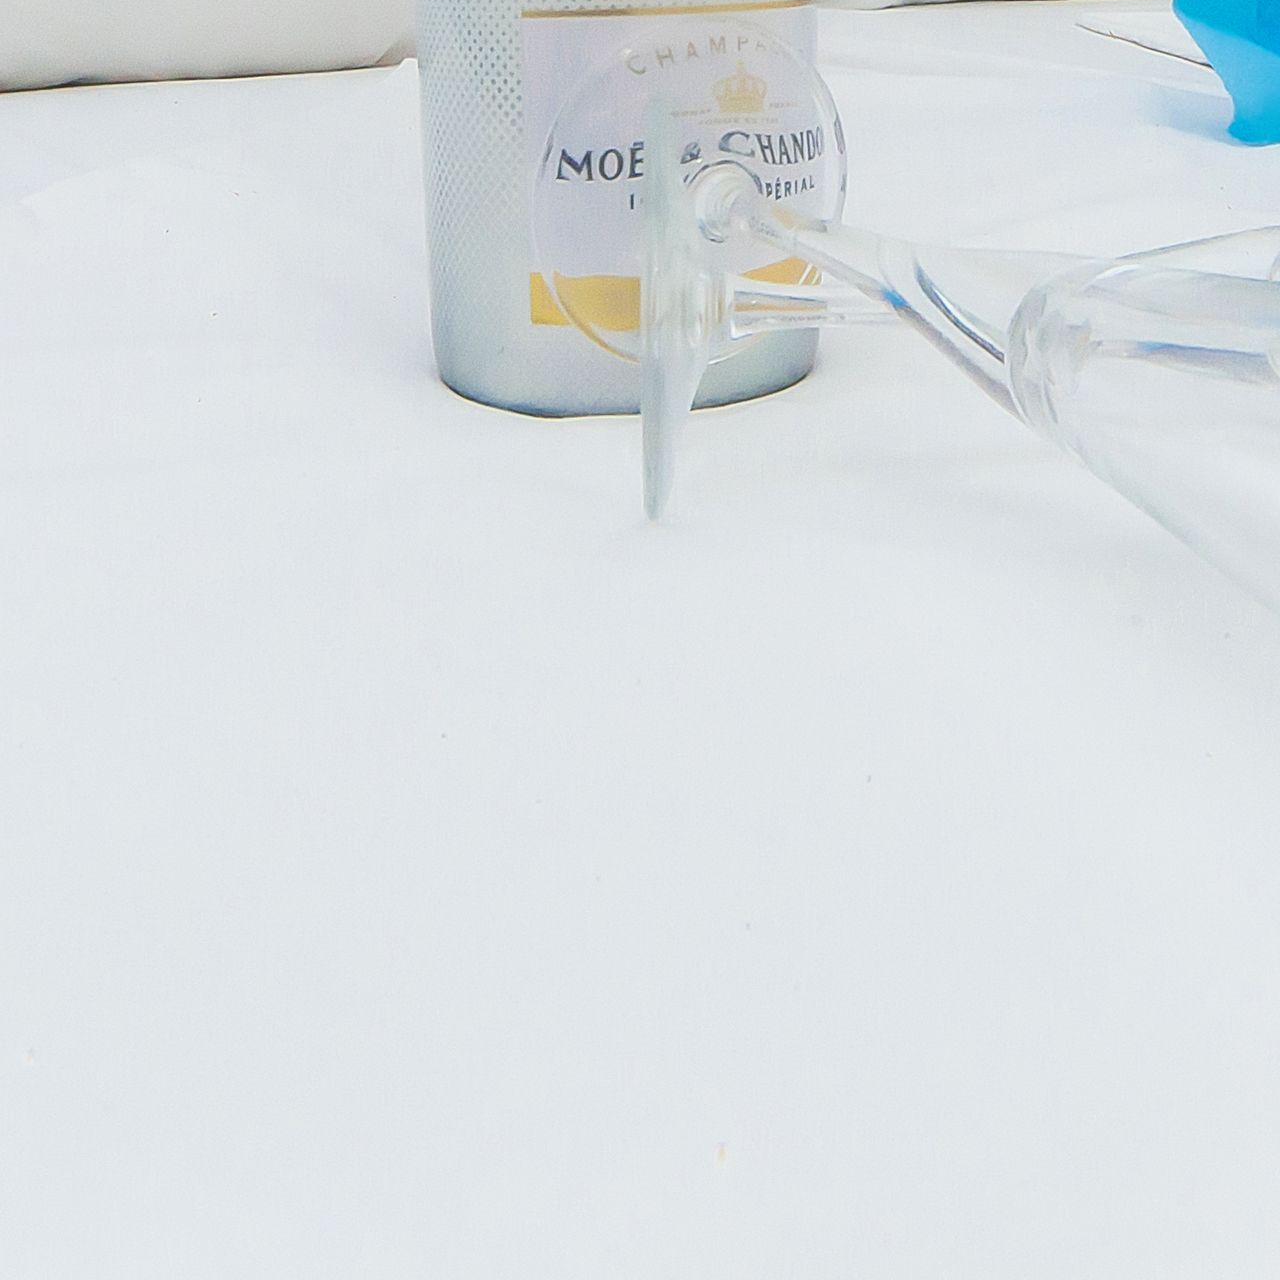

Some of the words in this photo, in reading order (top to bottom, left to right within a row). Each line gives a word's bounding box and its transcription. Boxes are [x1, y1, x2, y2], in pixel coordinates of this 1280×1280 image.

[624, 35, 780, 75] CHAMPA
[555, 140, 646, 182] MOË
[718, 125, 824, 166] CHANDO
[758, 174, 815, 201] PÉRIAL
